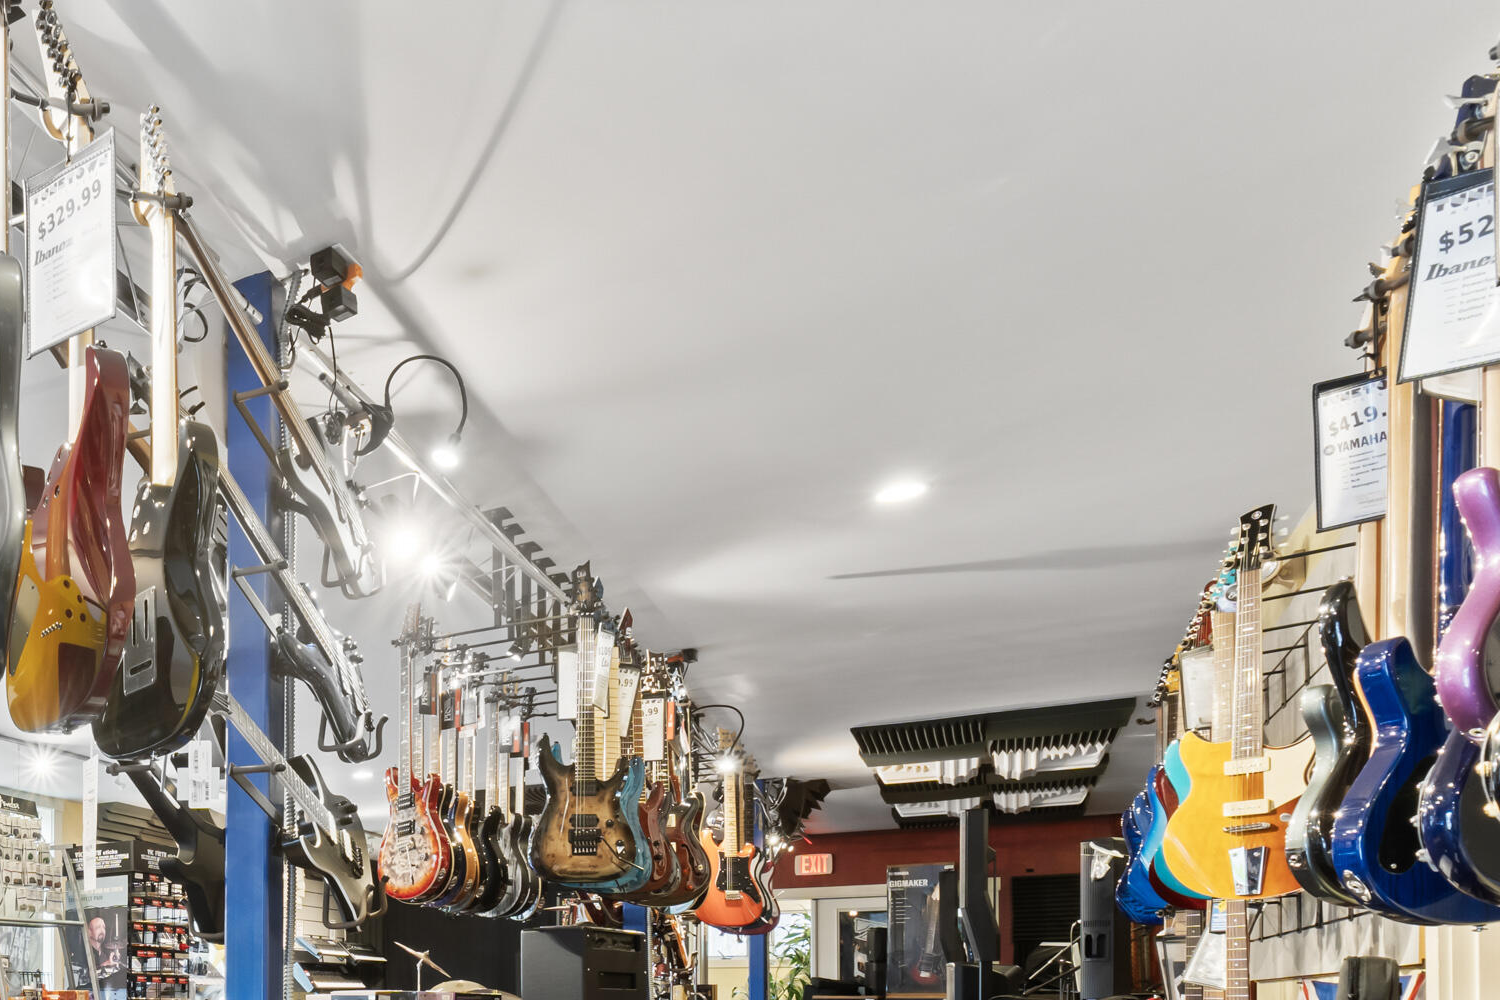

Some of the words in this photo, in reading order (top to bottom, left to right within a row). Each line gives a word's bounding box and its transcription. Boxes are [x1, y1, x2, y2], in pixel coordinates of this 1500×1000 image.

[38, 179, 101, 241] $329.99
[1424, 255, 1495, 282] Ibane
[1329, 405, 1387, 437] $419.
[1337, 431, 1387, 452] YAMAHA
[801, 854, 828, 874] EXIT
[889, 878, 928, 887] GIGMAKER
